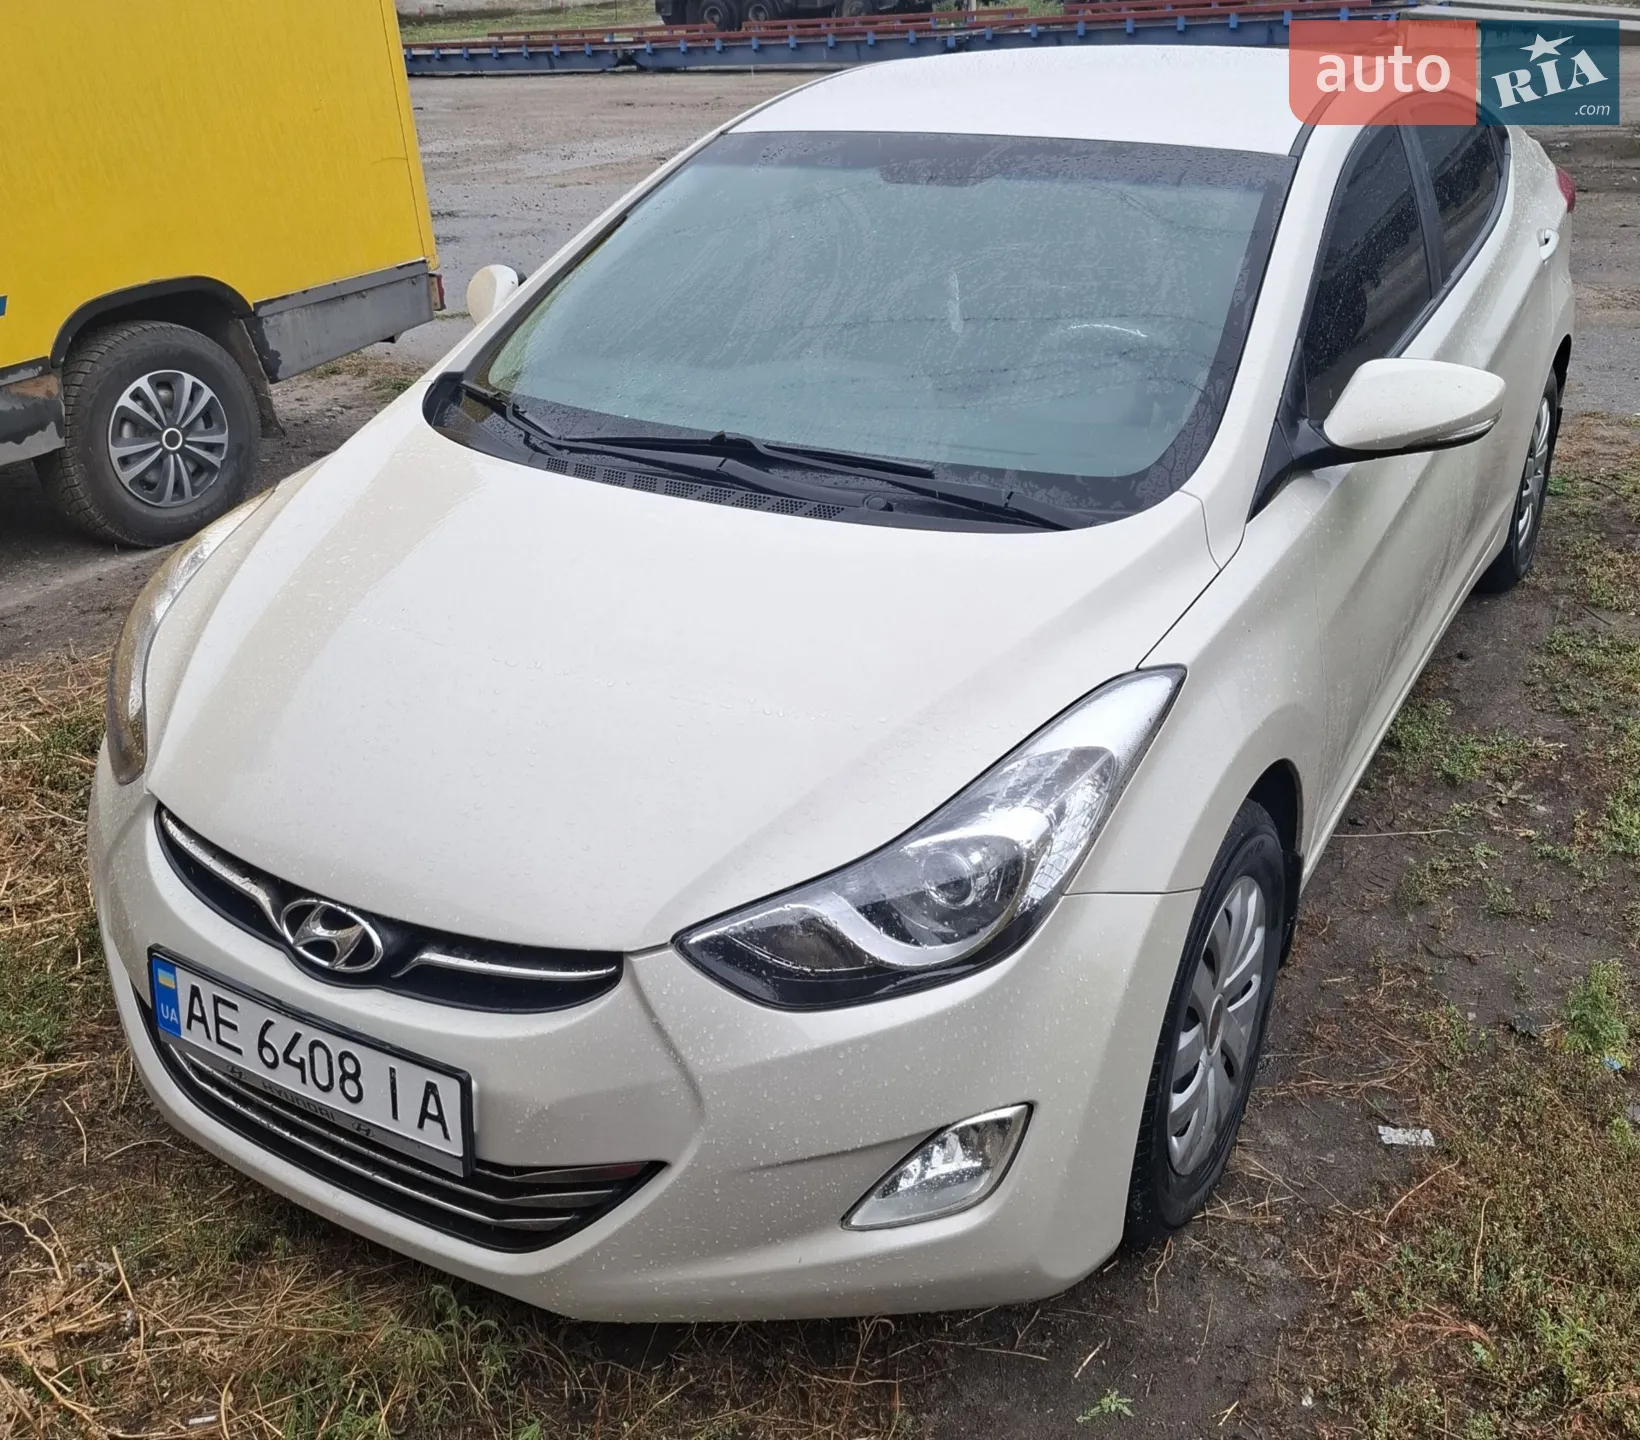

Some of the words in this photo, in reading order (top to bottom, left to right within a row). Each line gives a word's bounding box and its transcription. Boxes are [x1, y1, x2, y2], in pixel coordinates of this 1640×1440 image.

[161, 1002, 179, 1024] UA
[186, 983, 244, 1056] AE
[257, 1018, 364, 1104] 6408
[261, 1079, 336, 1122] HYUNDAI
